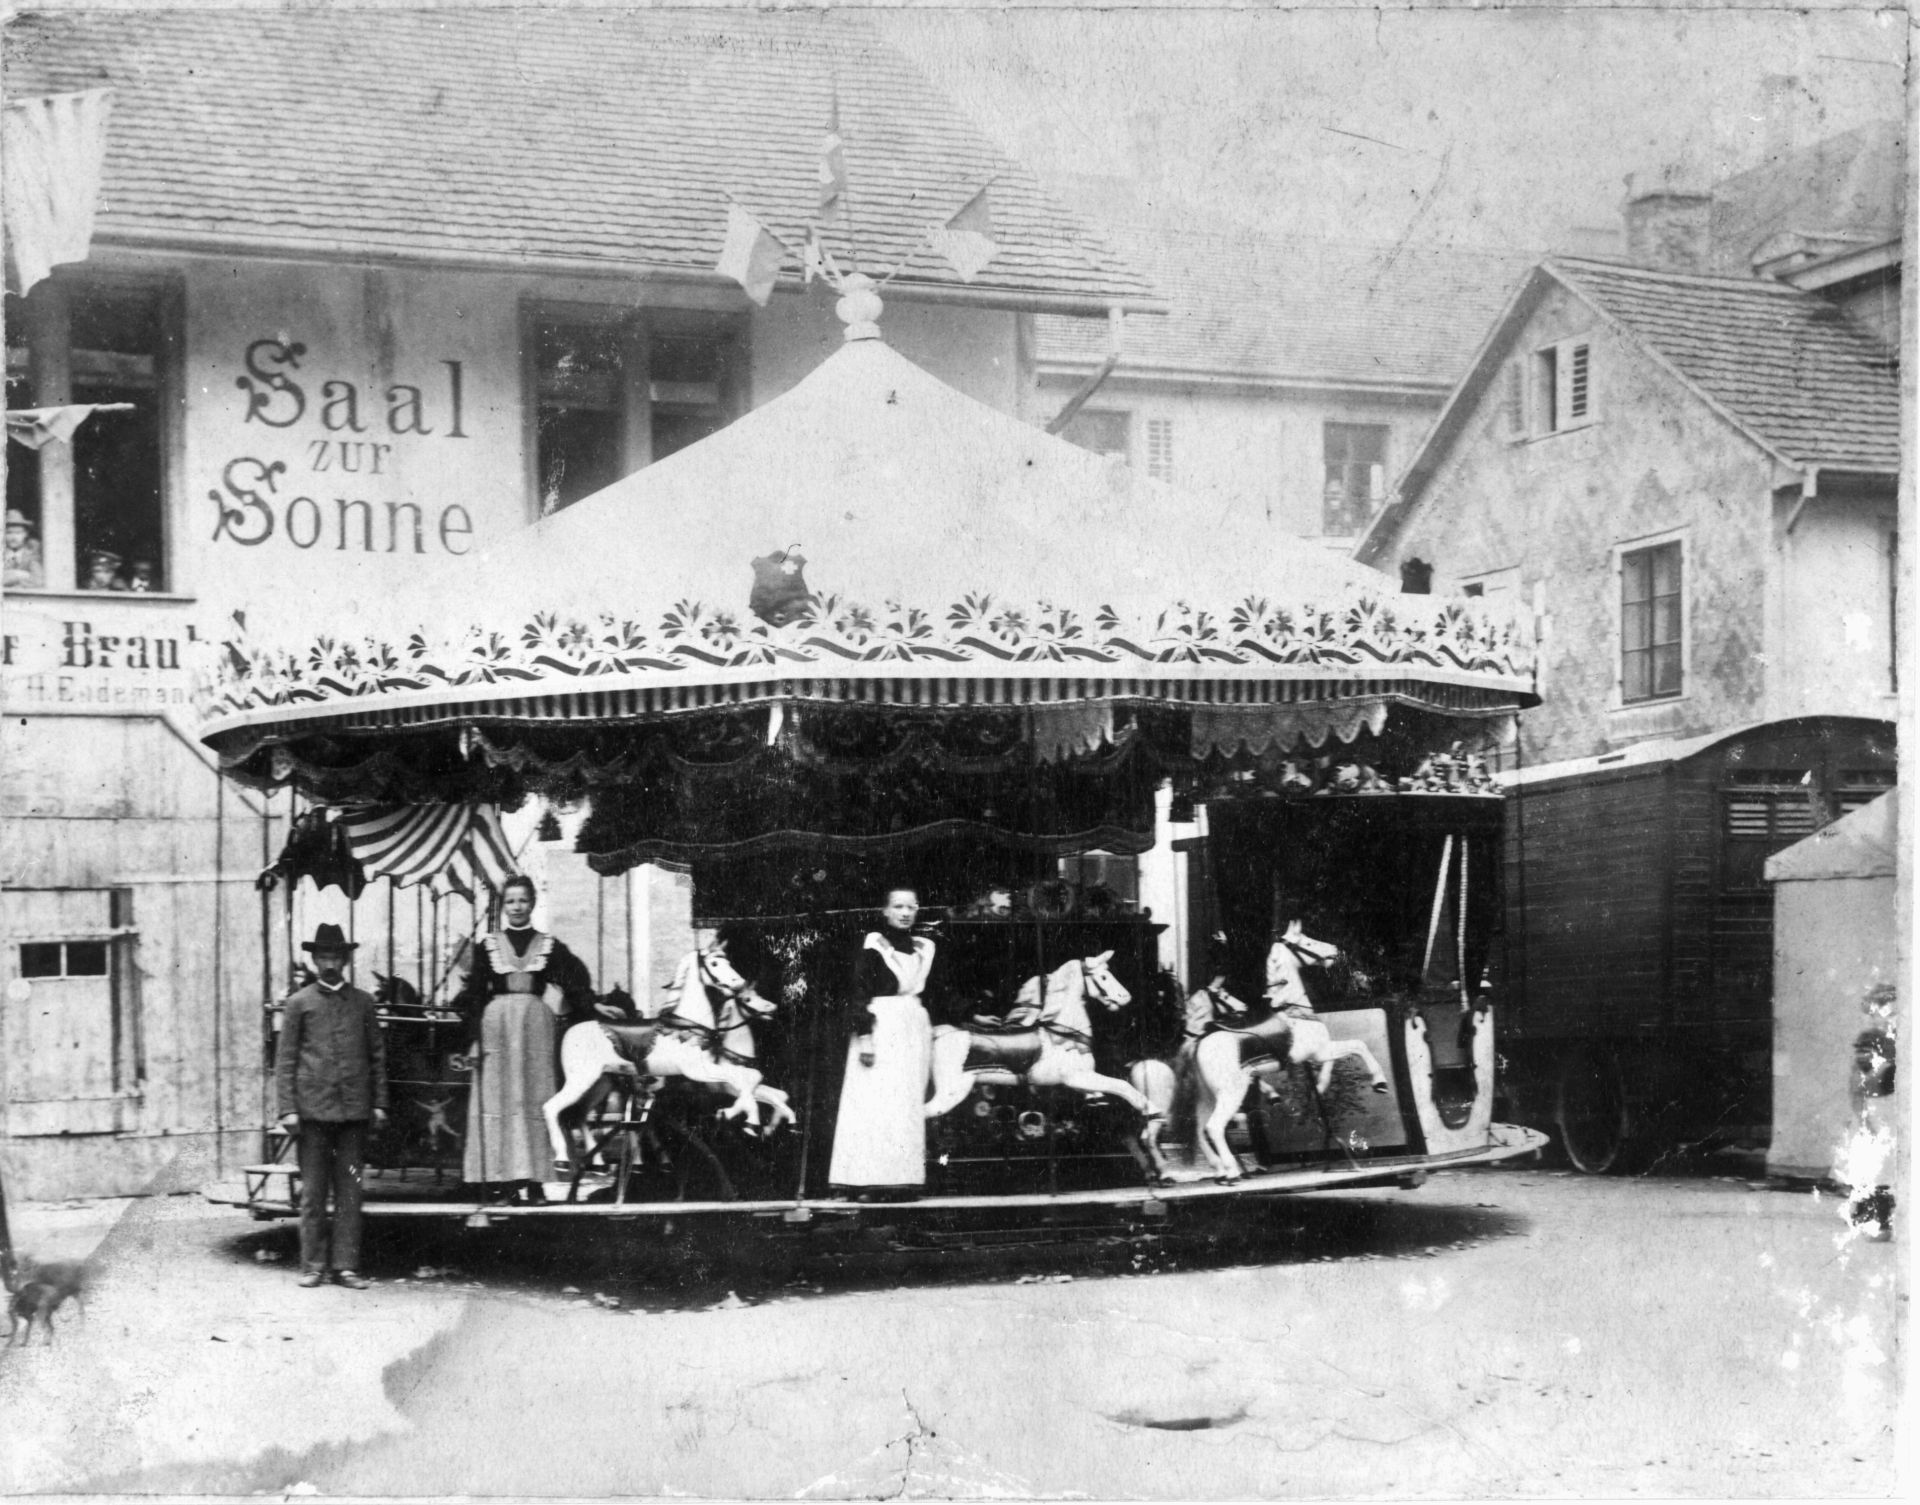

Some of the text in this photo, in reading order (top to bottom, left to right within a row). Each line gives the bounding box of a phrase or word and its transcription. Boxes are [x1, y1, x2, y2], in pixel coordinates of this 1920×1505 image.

[236, 339, 469, 438] Saal
[208, 457, 472, 556] Sonne
[308, 440, 391, 474] zur
